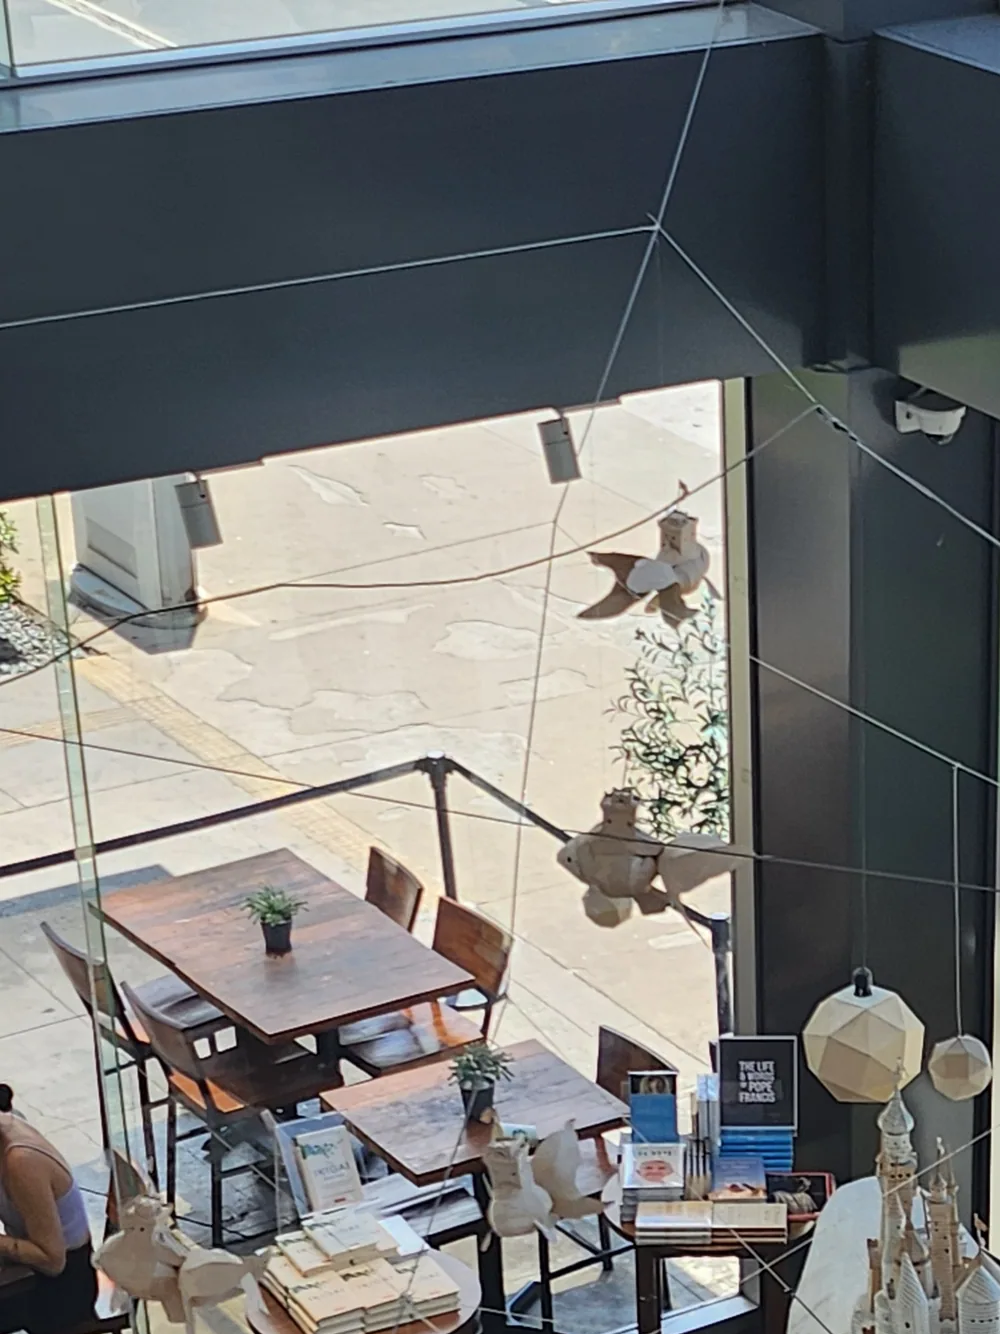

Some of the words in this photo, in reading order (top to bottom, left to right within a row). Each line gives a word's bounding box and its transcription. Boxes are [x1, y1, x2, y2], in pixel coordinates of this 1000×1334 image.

[739, 1061, 755, 1072] THE
[757, 1061, 775, 1072] LIFE
[748, 1082, 773, 1092] POPE
[739, 1092, 776, 1103] FRANCIS
